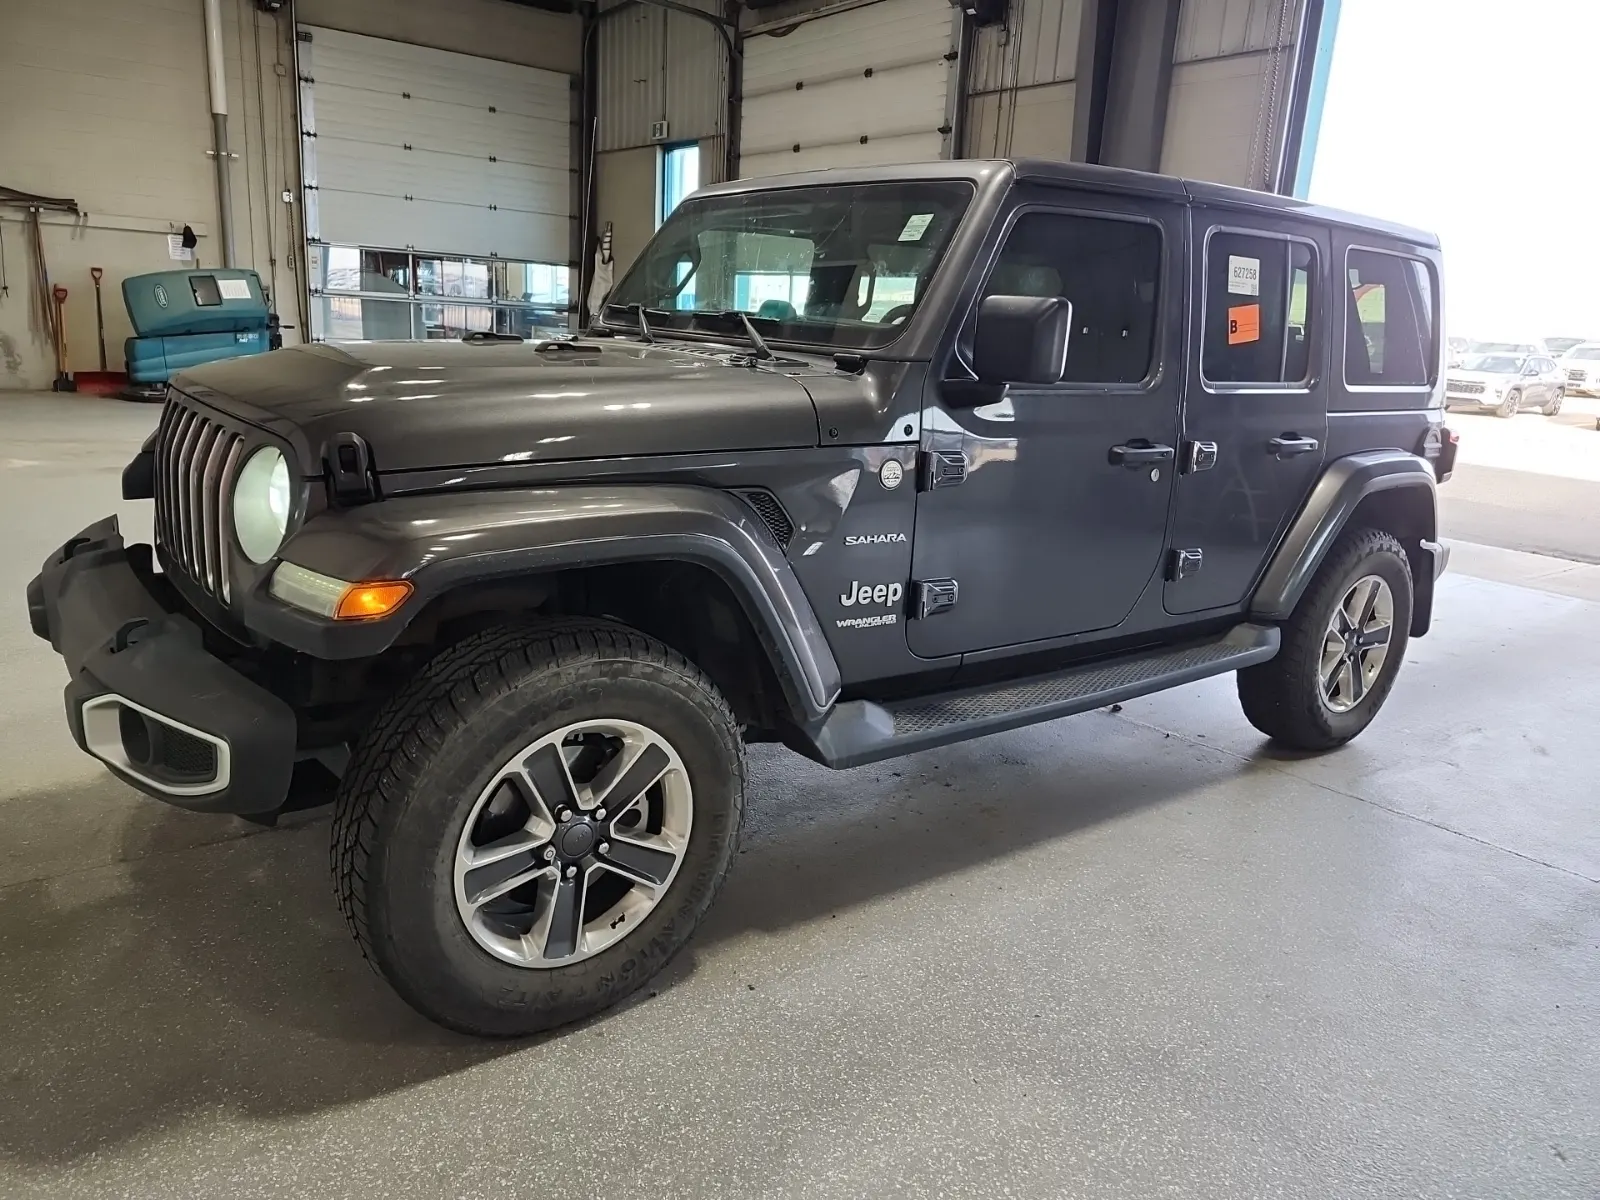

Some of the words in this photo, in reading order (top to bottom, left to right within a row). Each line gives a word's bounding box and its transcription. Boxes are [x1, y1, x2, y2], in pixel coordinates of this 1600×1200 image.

[1233, 266, 1257, 280] 627258
[1230, 320, 1238, 334] B
[845, 533, 907, 546] SAHARA
[840, 581, 902, 607] Jeep
[836, 614, 896, 628] WRANGLER
[854, 620, 896, 629] UNLIMITED
